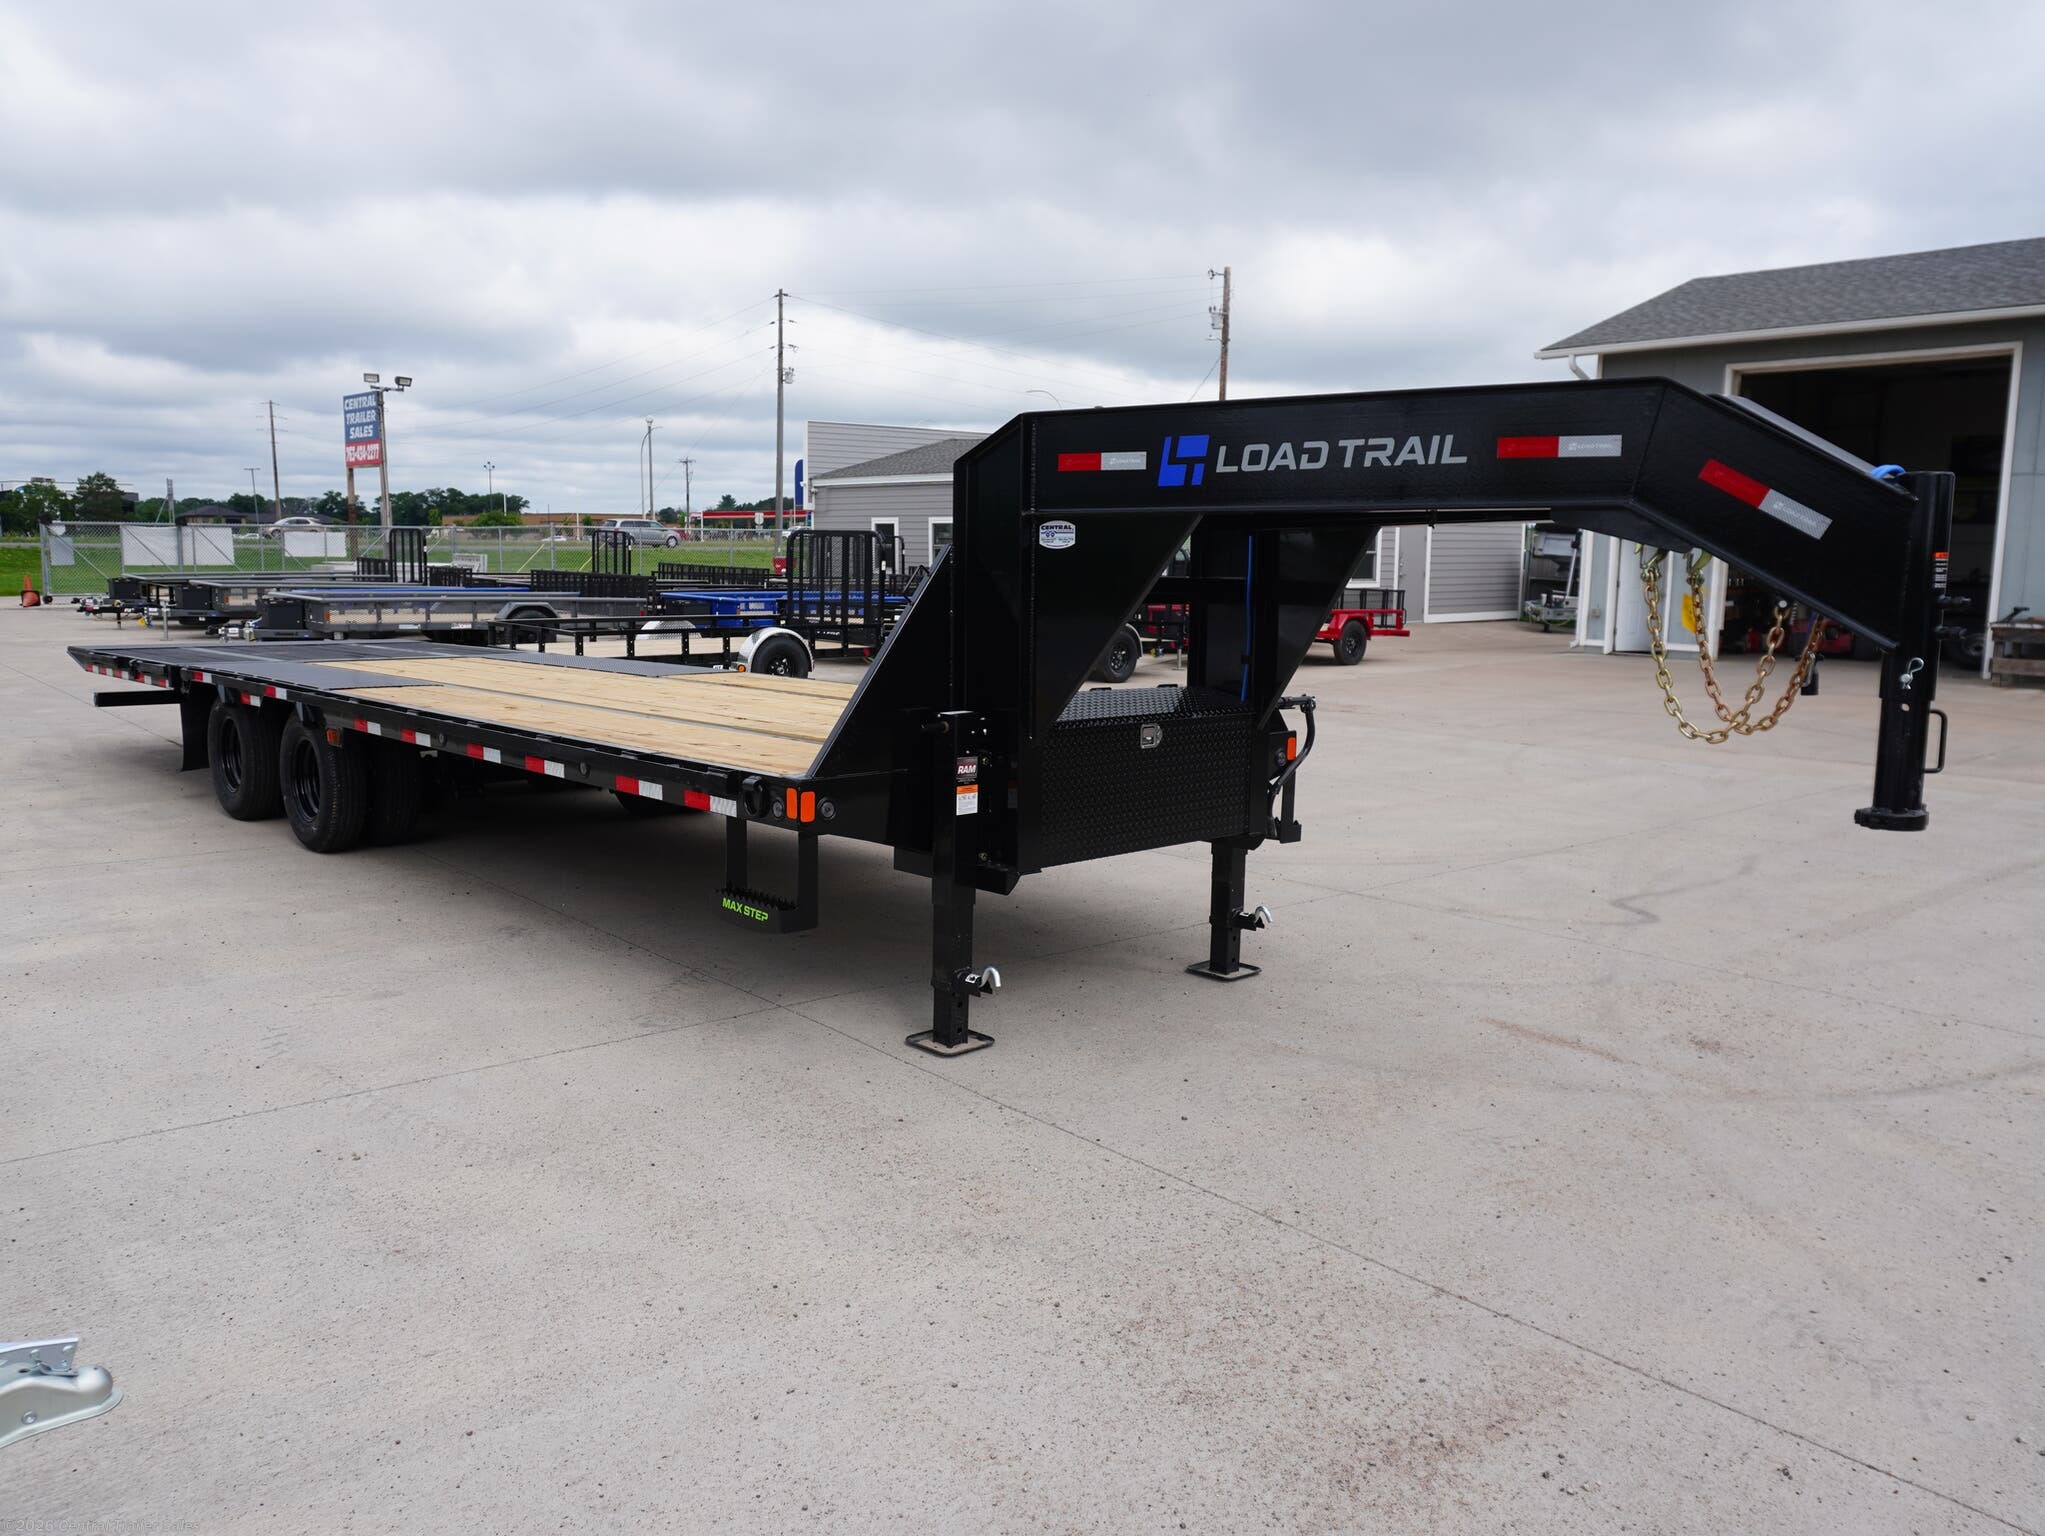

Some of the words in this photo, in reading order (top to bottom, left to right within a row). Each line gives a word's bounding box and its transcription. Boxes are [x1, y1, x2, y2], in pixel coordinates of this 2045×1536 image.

[344, 395, 376, 411] CENTRAL
[346, 409, 376, 425] TRAILER
[349, 425, 373, 439] SALES
[1216, 440, 1330, 473] LOAD
[1338, 434, 1468, 468] TRAIL
[957, 765, 977, 775] RAM
[722, 897, 742, 914] MAX
[743, 905, 769, 921] STEP
